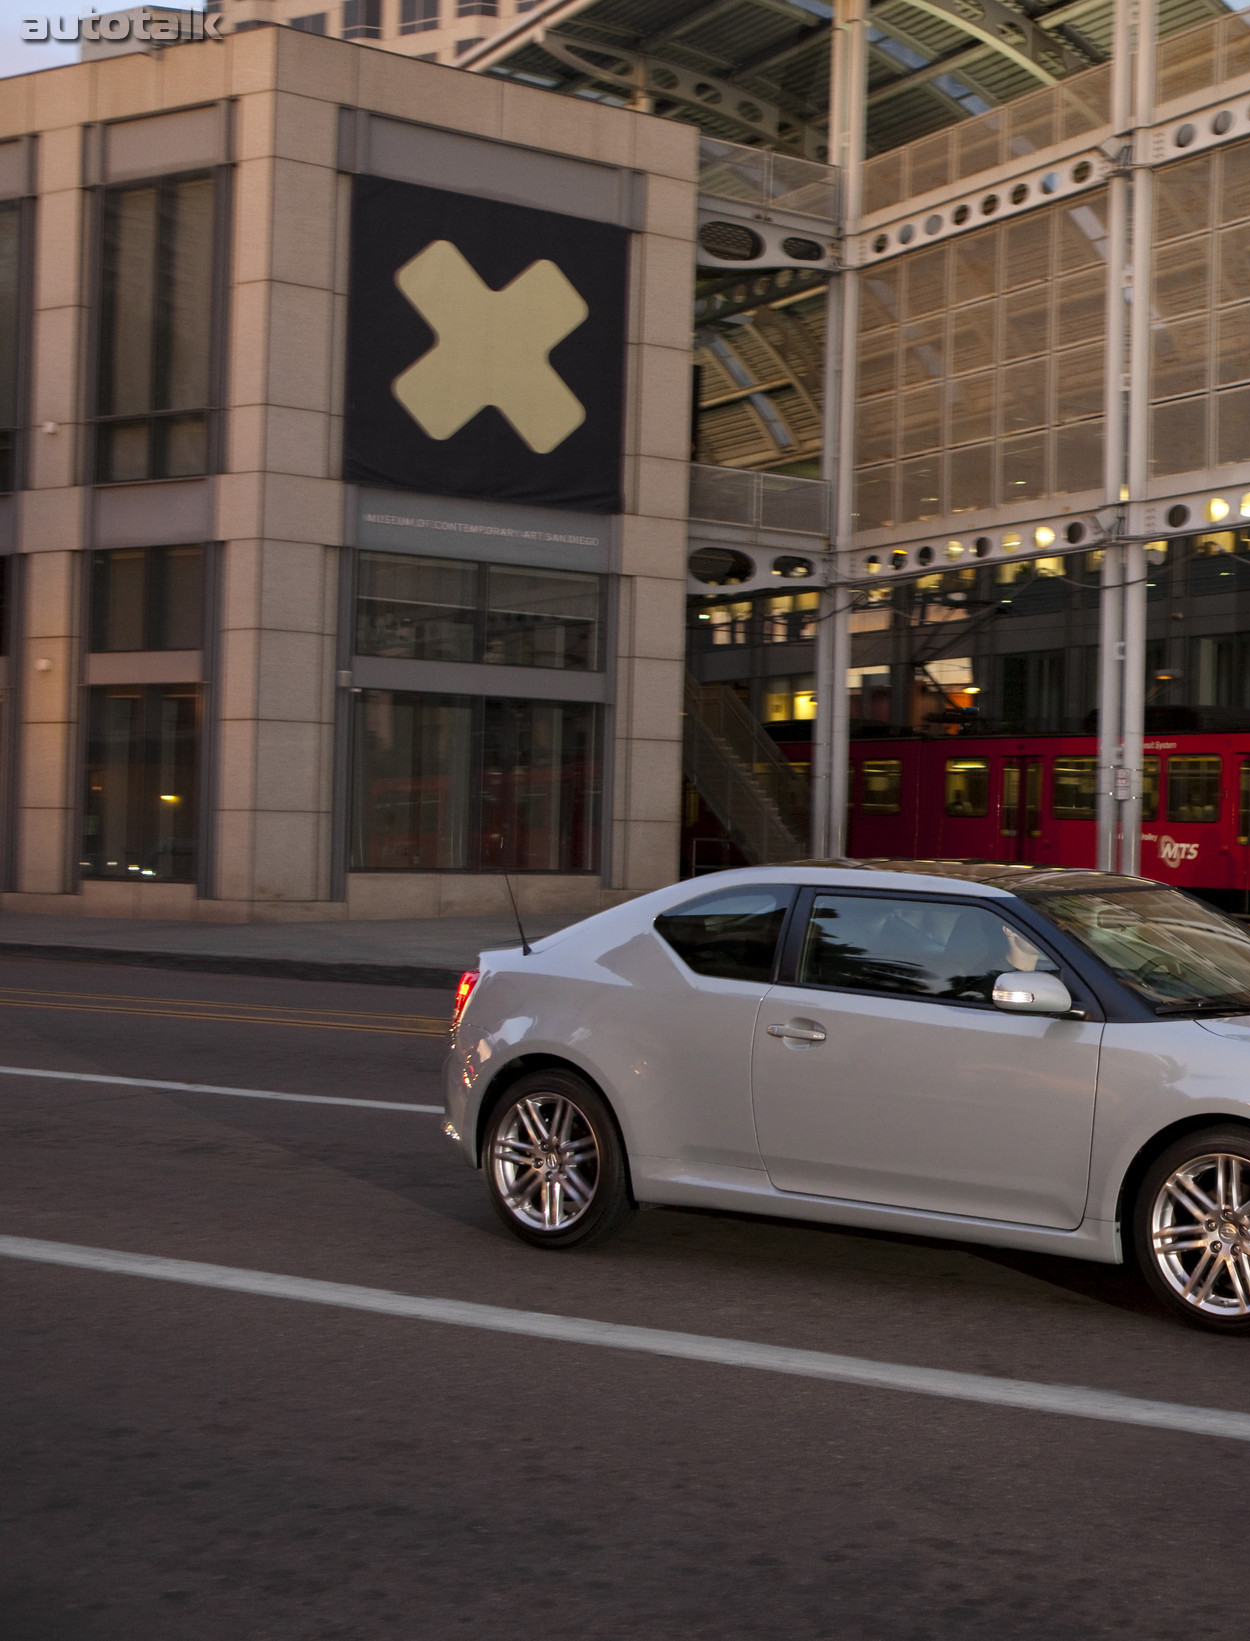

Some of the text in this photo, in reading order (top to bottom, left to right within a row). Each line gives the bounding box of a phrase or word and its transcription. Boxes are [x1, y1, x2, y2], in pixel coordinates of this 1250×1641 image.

[364, 513, 600, 546] MUSEUM OF CONTEMPORARY ART SAN DIEGO
[1158, 841, 1200, 861] MTS
